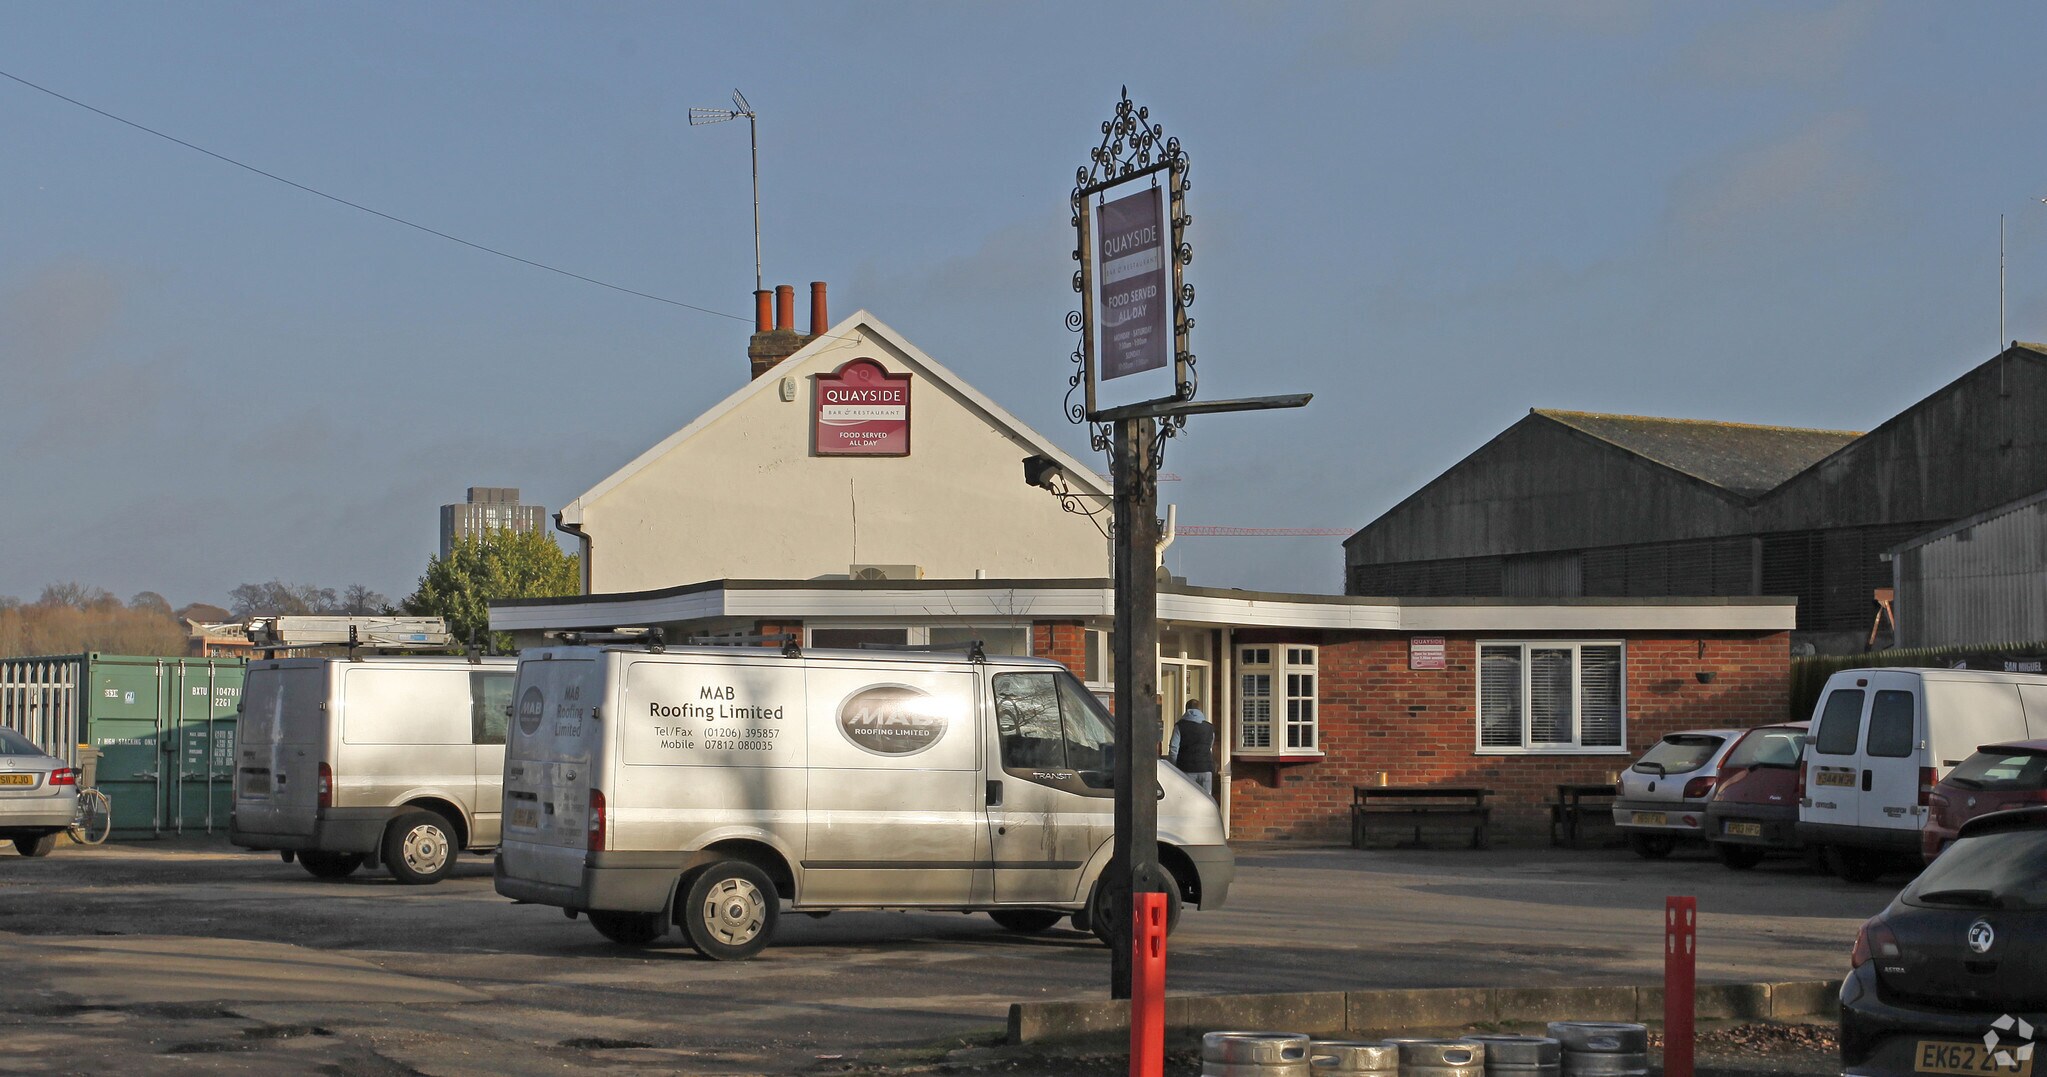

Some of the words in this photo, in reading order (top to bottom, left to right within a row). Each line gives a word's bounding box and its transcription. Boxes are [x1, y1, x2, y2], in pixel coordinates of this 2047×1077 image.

[1104, 225, 1157, 257] QUAYSIDE
[1123, 256, 1157, 270] RESTAURANT
[1108, 293, 1129, 309] FOOD
[1130, 285, 1157, 303] SERVED
[1119, 309, 1131, 322] ALL
[1132, 305, 1147, 319] DAY
[826, 390, 901, 403] QUAYSIDE
[2004, 661, 2018, 672] SAN
[2018, 661, 2043, 672] MIGUEL
[192, 687, 208, 696] BXTU
[564, 685, 580, 701] MAB
[700, 686, 735, 700] MAB
[520, 702, 542, 714] MAB
[556, 703, 583, 722] Roofing
[650, 702, 715, 721] Roofing
[720, 704, 783, 719] Limited
[554, 722, 582, 737] Limited
[654, 726, 693, 737] Tel/Fax
[704, 727, 741, 739] (01206)
[745, 728, 780, 739] 395857
[855, 728, 893, 736] ROOFING
[660, 740, 694, 749] Mobile
[704, 740, 735, 750] 07812
[737, 741, 773, 750] 080035
[1032, 772, 1073, 780] TRANSIT
[1922, 1044, 1976, 1071] EK62
